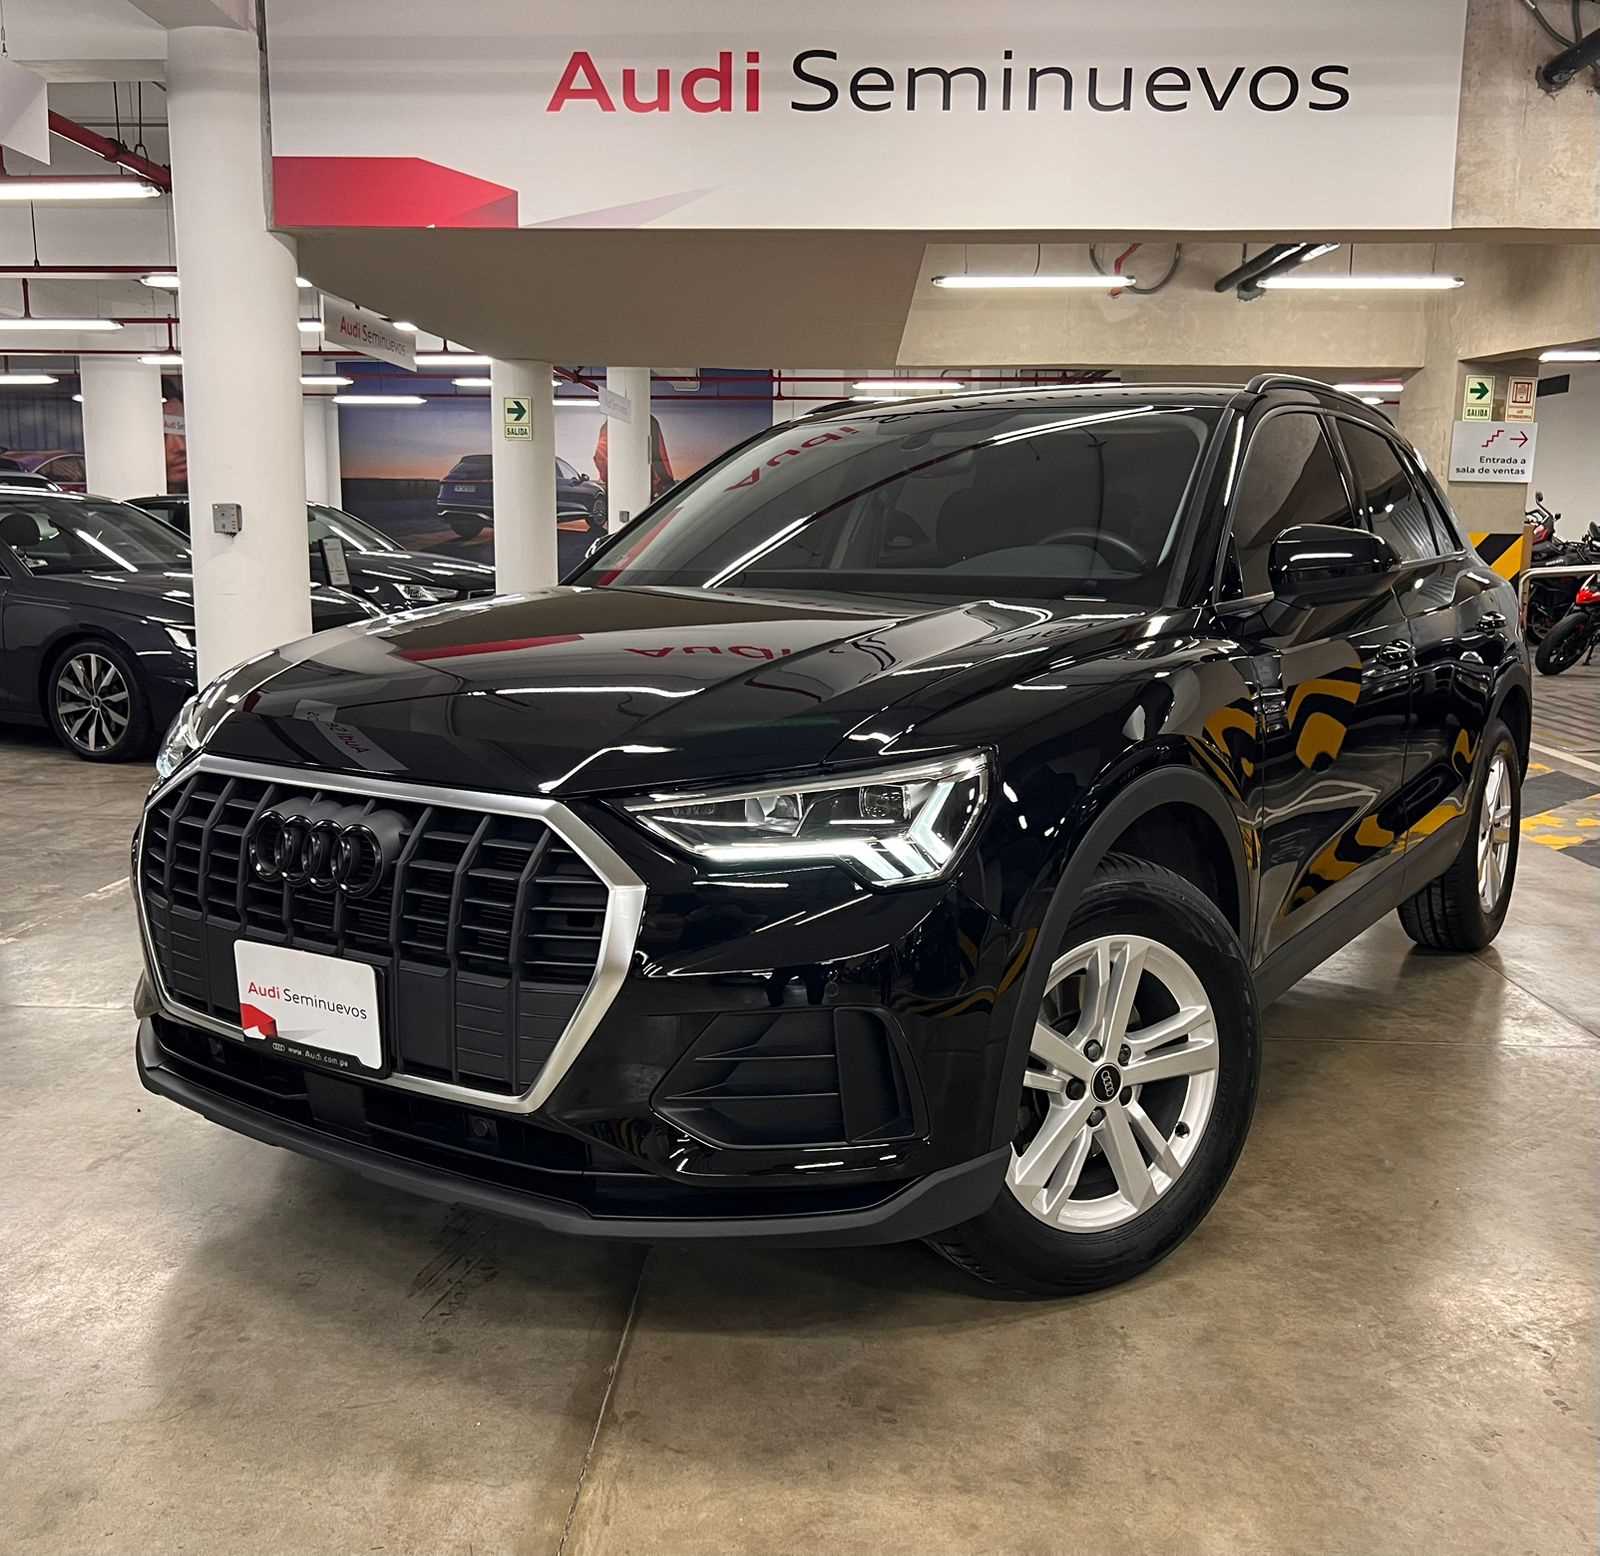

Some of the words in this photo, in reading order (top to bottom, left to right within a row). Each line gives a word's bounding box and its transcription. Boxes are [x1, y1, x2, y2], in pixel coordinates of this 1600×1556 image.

[546, 51, 760, 113] Audi
[791, 49, 1350, 113] Seminuevos
[340, 316, 360, 337] Audi
[362, 324, 407, 356] Seminuevos
[1467, 408, 1488, 417] SALIDA
[506, 427, 528, 436] SALIDA
[1479, 456, 1518, 465] Entrada
[1520, 457, 1526, 465] a
[1456, 466, 1475, 474] sala
[1478, 466, 1490, 474] de
[1493, 467, 1525, 475] ventas
[248, 981, 281, 1000] Audi
[283, 988, 368, 1020] Seminuevos
